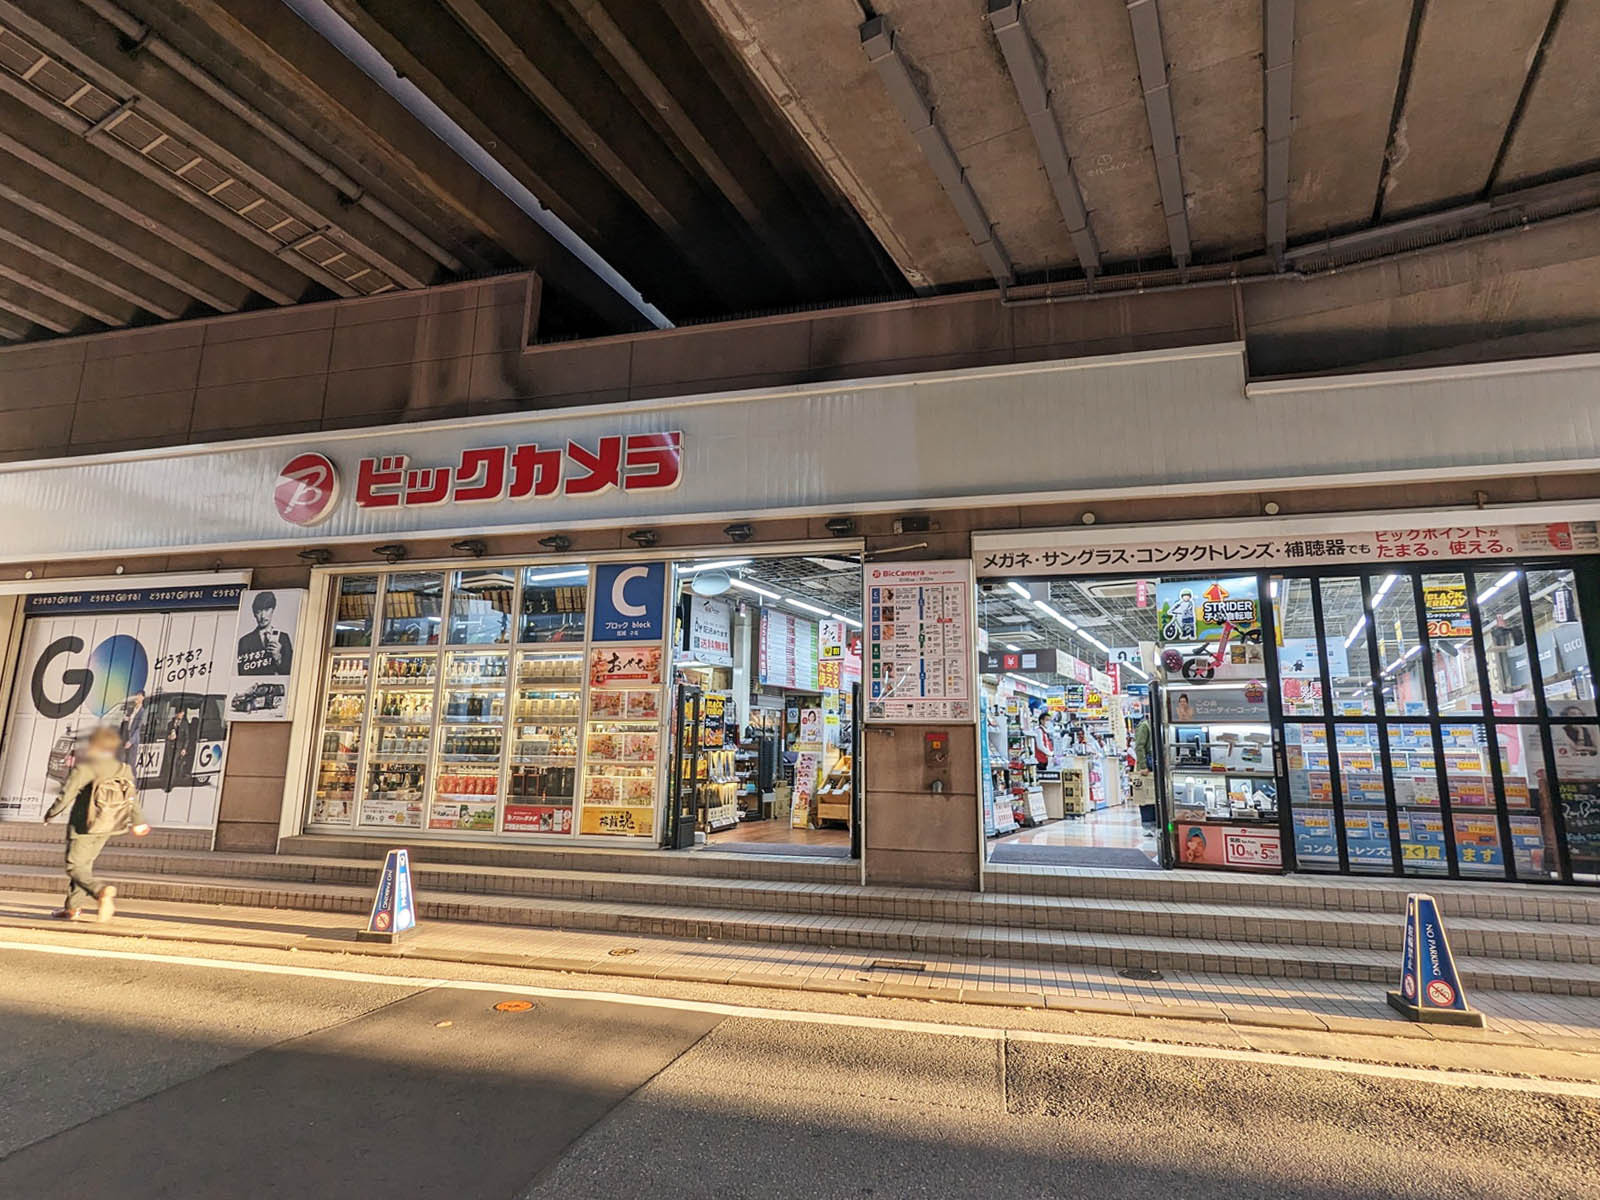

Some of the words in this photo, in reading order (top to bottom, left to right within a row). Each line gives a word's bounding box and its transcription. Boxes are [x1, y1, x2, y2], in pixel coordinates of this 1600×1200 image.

[355, 431, 684, 509] ビックカメラ
[882, 570, 926, 578] BicCamera
[611, 566, 649, 617] C
[1426, 590, 1464, 601] BLACK
[1204, 601, 1253, 612] STRIDER
[1425, 598, 1466, 609] FRIDAY
[605, 621, 629, 630] ブロック
[632, 620, 651, 629] block
[154, 648, 203, 670] どうする?
[167, 661, 213, 683] GOする!
[1425, 923, 1435, 939] NO
[1427, 939, 1442, 976] PARKING
